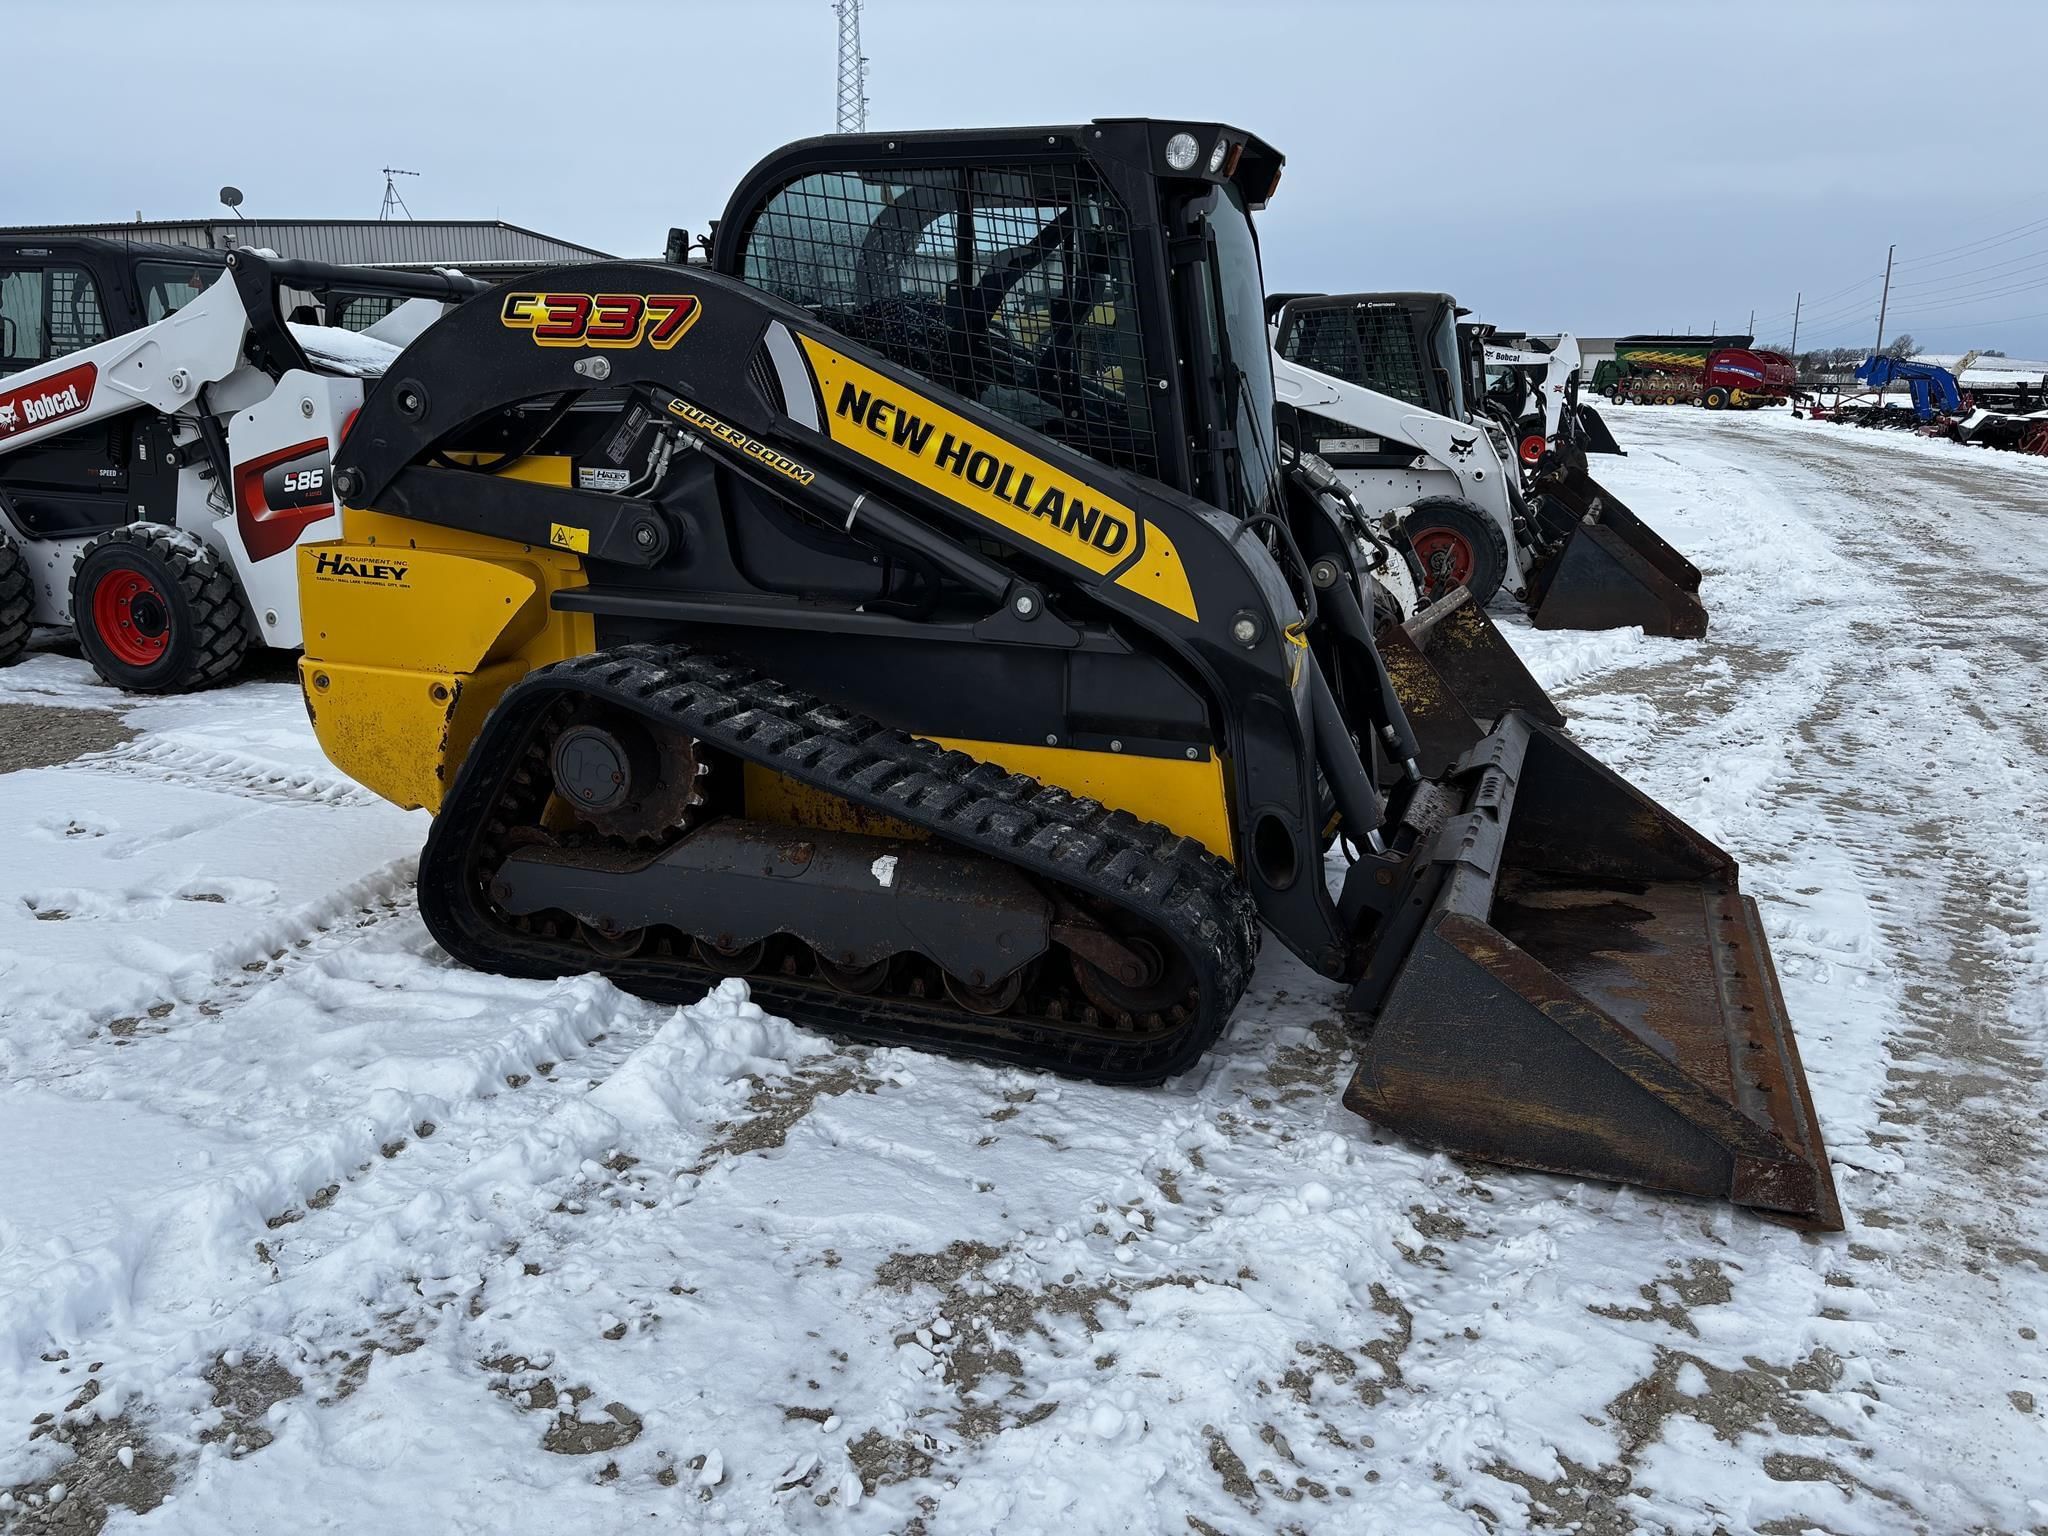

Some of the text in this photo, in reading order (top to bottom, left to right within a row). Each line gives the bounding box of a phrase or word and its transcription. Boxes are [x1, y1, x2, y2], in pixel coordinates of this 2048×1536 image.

[1495, 352, 1520, 363] Bobcat
[21, 384, 81, 424] Bobcat
[668, 398, 746, 449] SUPER
[743, 439, 815, 486] BOOM
[99, 469, 117, 477] SPEED
[835, 381, 1130, 557] NEW HOLLAND
[316, 552, 408, 580] HALEY
[344, 556, 391, 565] EQUIPMENT
